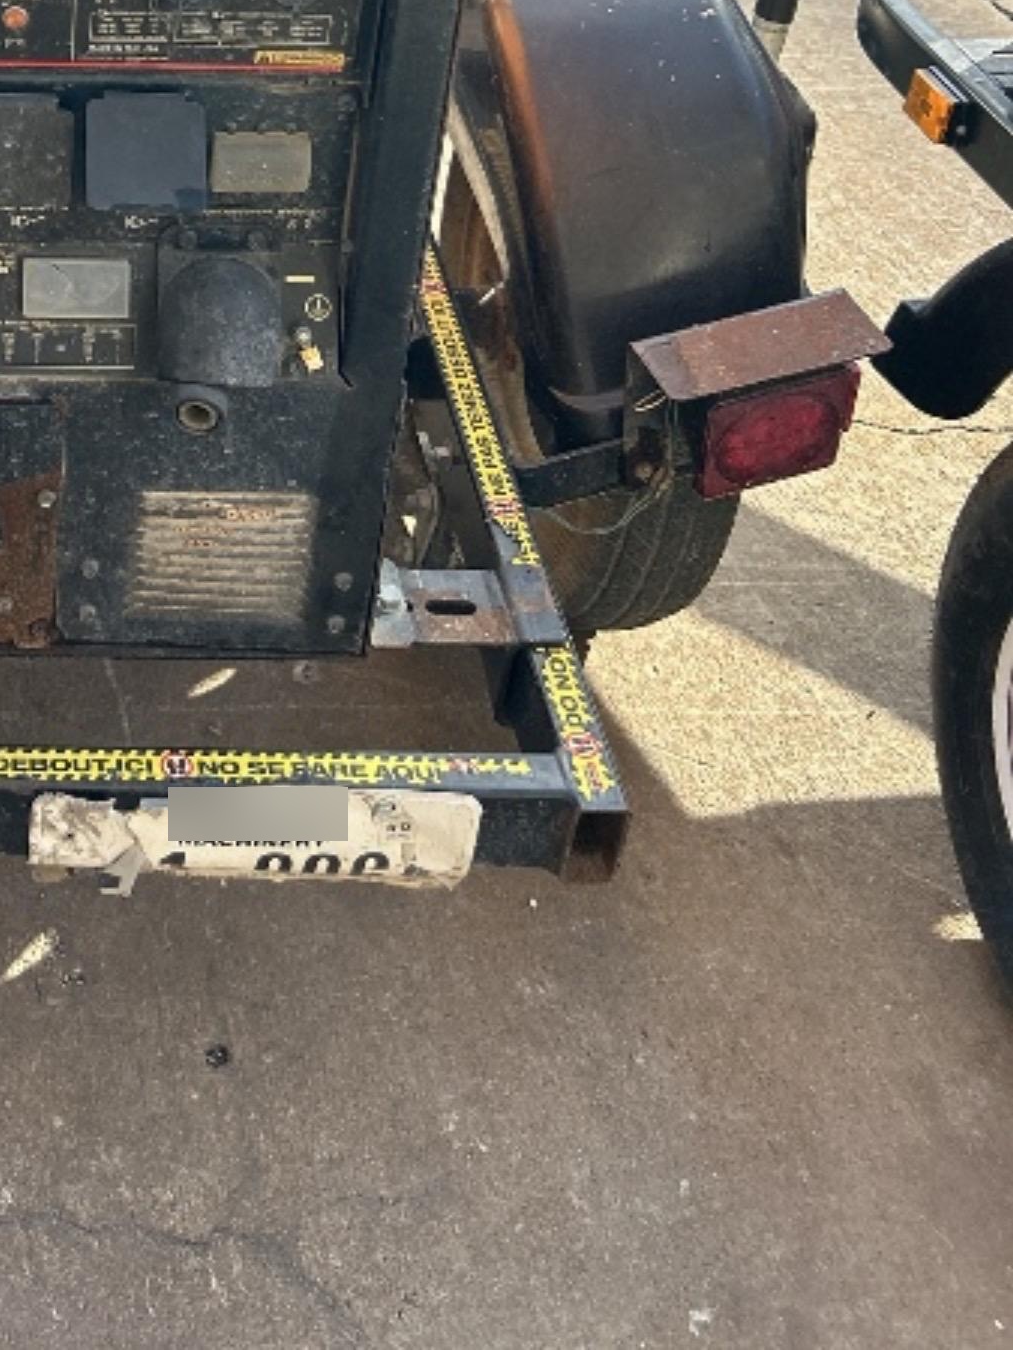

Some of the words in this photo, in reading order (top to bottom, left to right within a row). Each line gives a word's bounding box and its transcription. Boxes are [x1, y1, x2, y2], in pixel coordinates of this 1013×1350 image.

[559, 696, 582, 726] DO
[114, 758, 153, 772] ICI
[198, 761, 239, 775] NO
[247, 761, 285, 775] SE
